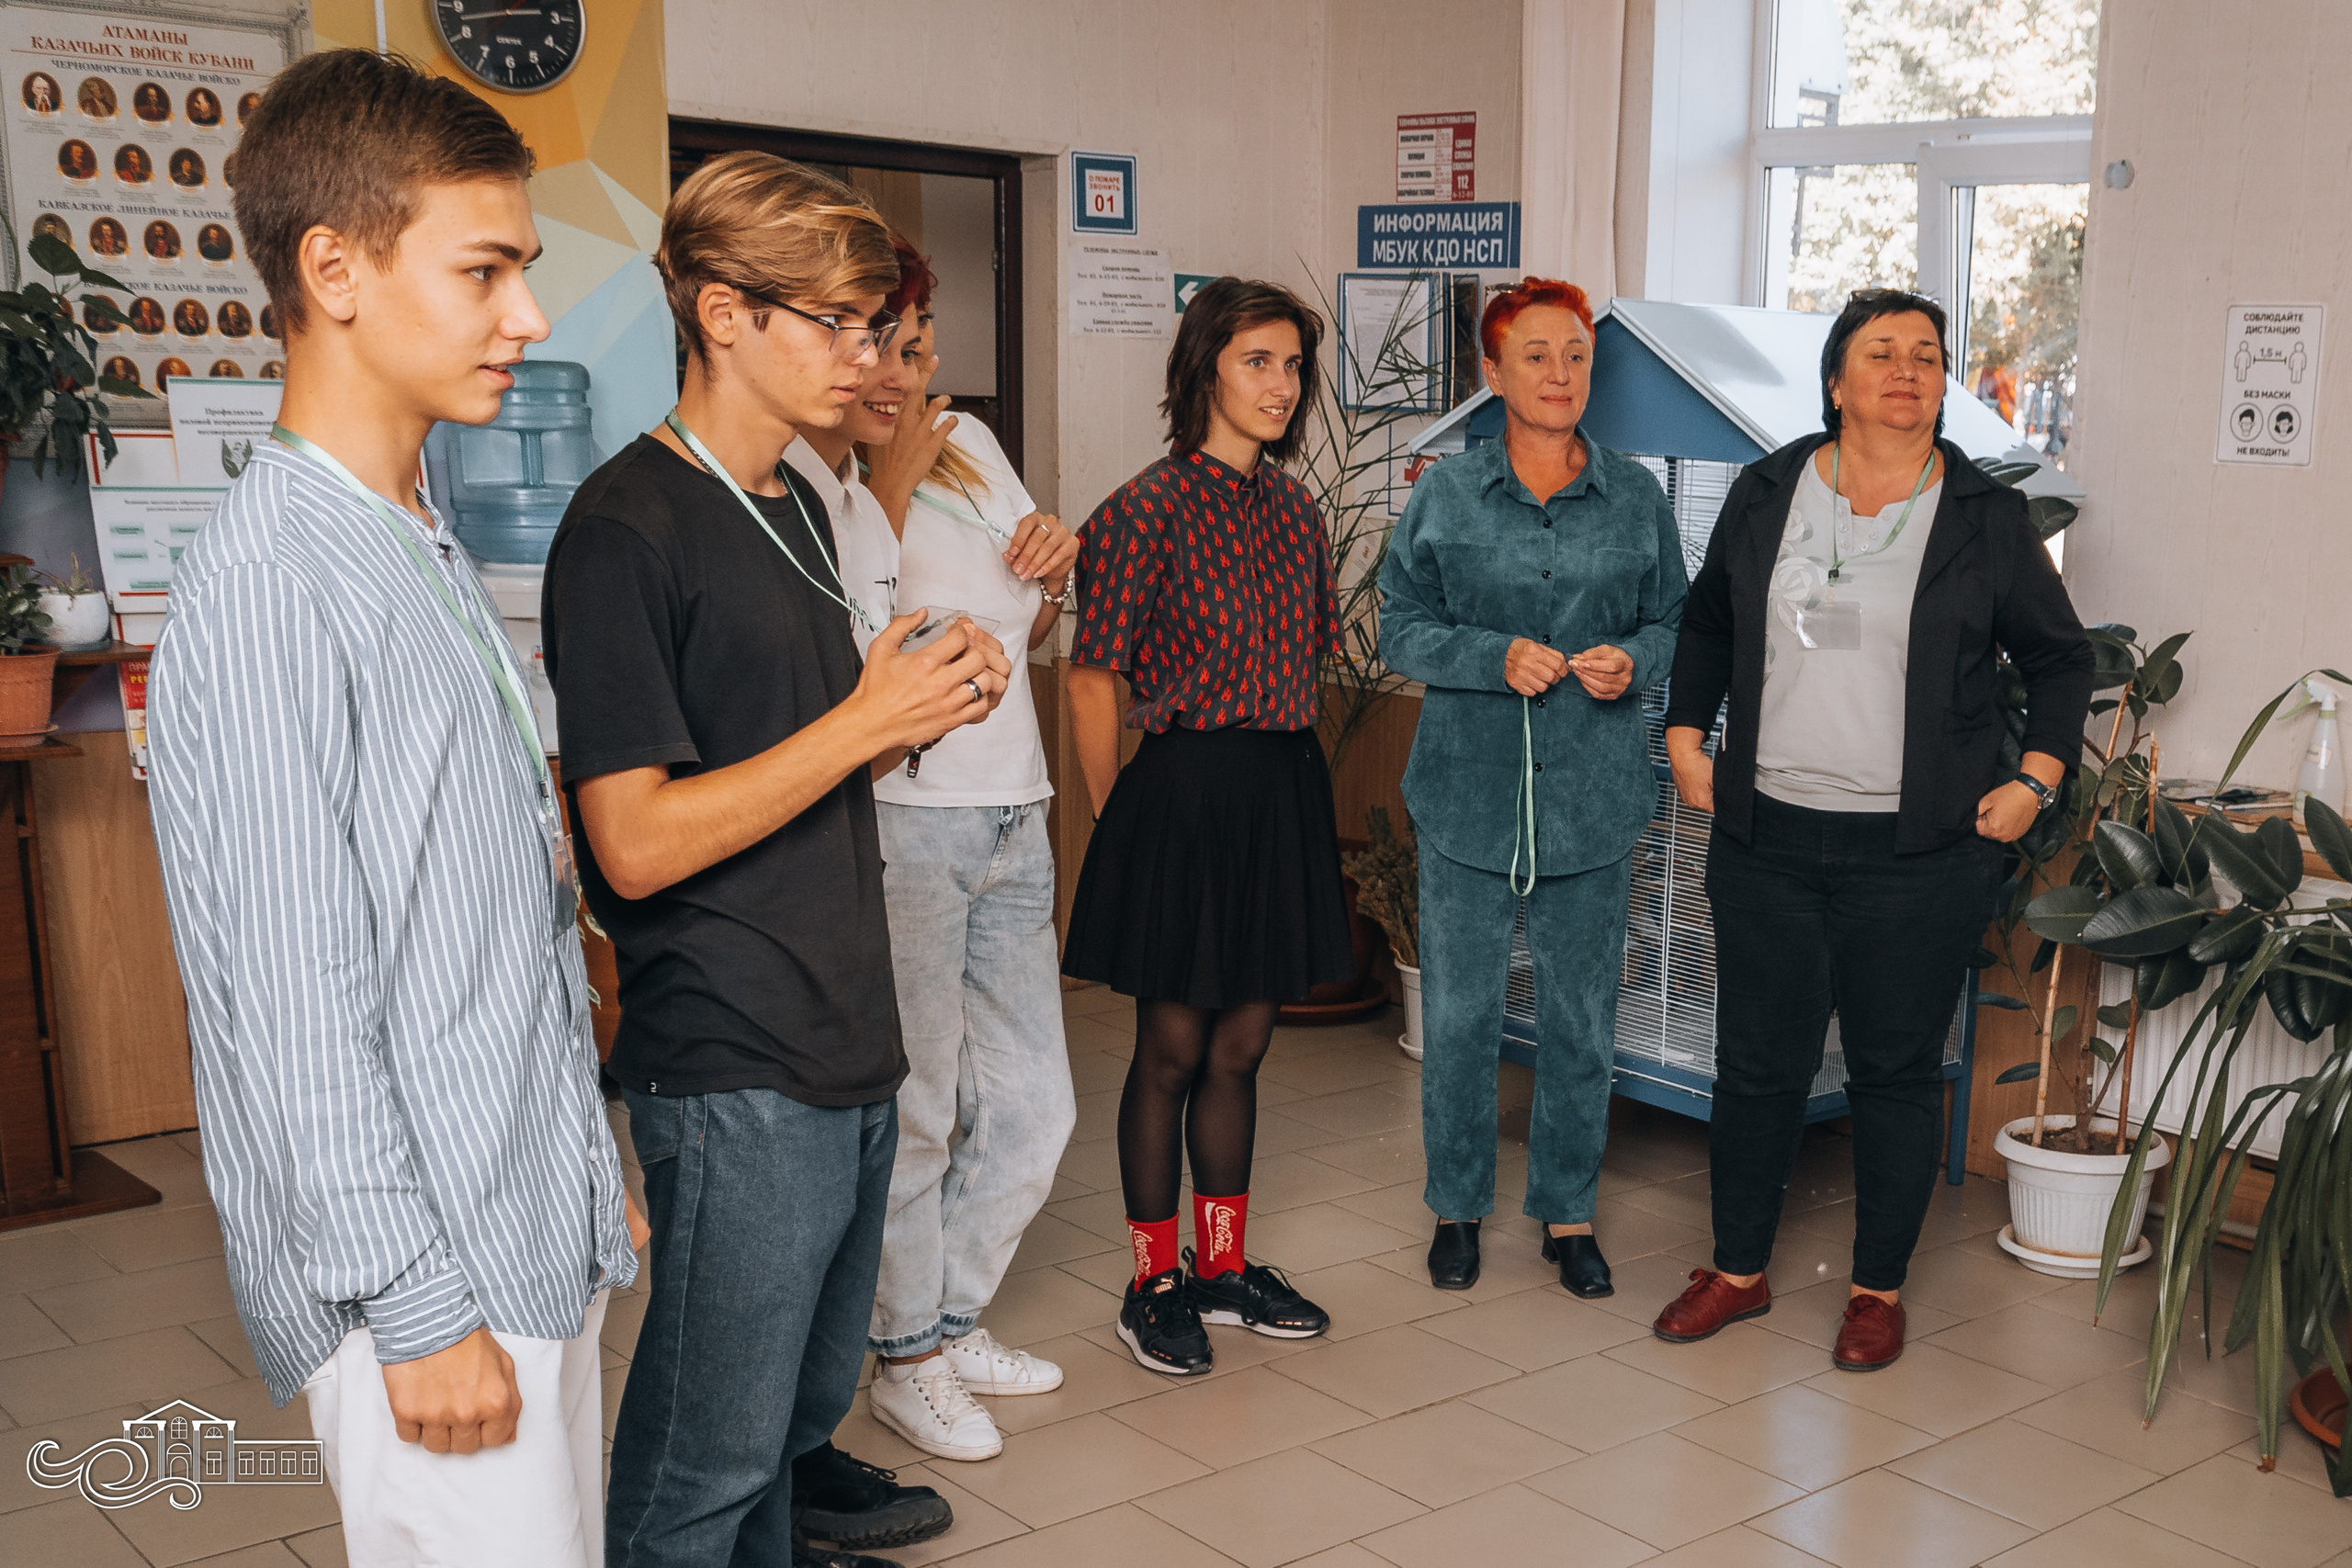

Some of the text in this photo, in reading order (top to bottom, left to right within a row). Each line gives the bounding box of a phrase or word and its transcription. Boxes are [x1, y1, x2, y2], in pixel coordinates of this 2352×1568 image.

[453, 0, 464, 14] 9
[550, 11, 560, 25] 3
[103, 24, 189, 46] АТАМАНЫ
[461, 25, 472, 39] 8
[544, 35, 555, 48] 4
[30, 35, 255, 71] КАЗАЧЬИХ ВОЙСК КУБАНИ
[480, 45, 491, 59] 7
[528, 50, 539, 64] 5
[505, 54, 516, 69] 6
[51, 59, 241, 86] ЧЕРНОМОРСКОЕ КАЗАЧЬЕ ВОЙСКО
[1095, 175, 1120, 184] ПОЖАРЕ
[38, 199, 232, 220] КАВКАЗСКОЕ ЛИНЕЙНОЕ КАЗАЧЬЕ
[1094, 194, 1114, 213] 01
[1374, 211, 1503, 235] ИНФОРМАЦИЯ
[1373, 238, 1503, 266] МБУК КДО НСП
[154, 282, 203, 294] КАЗАЧЬЕ
[2244, 310, 2304, 322] СОБЛЮДАЙТЕ
[2245, 325, 2301, 335] ДИСТАНЦИЮ
[2244, 389, 2291, 400] БЕЗ МАСКИ
[2236, 446, 2290, 457] НЕ ВХОДИТЬ!
[129, 661, 148, 671] ПРА
